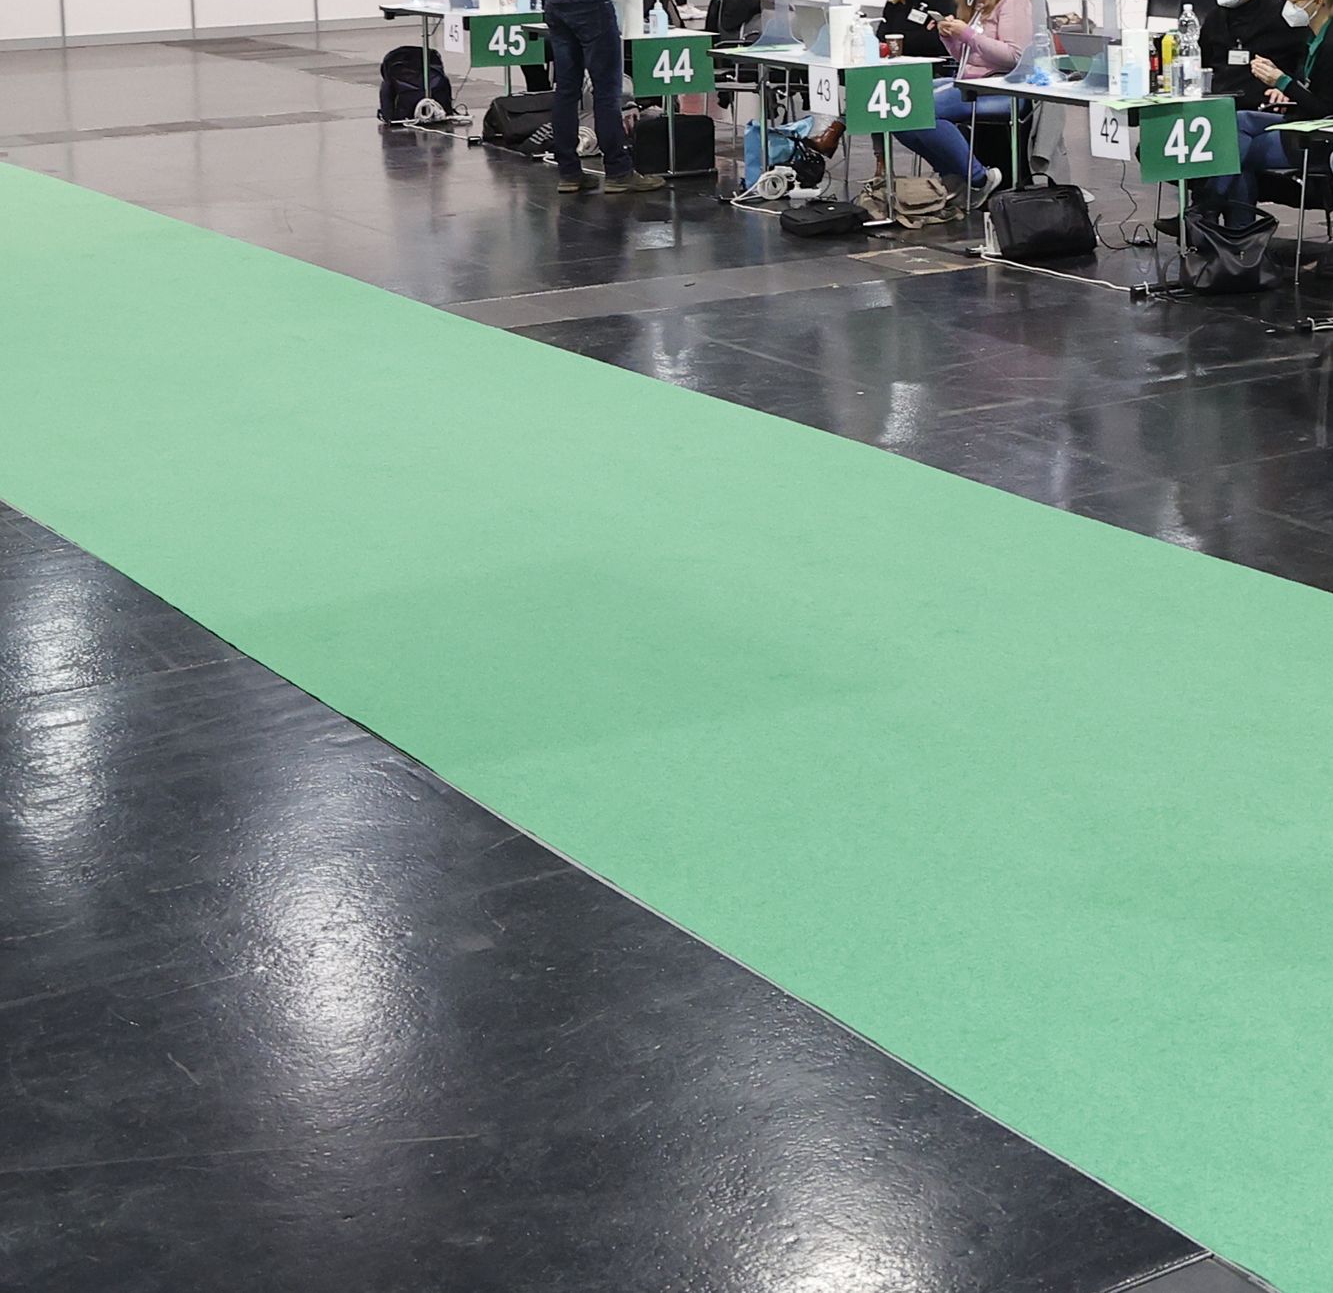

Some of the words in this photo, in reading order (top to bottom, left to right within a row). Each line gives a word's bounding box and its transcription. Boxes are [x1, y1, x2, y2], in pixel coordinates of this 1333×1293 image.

[448, 23, 460, 44] 45
[488, 25, 526, 57] 45
[652, 48, 694, 84] 44
[816, 78, 831, 102] 43
[867, 78, 912, 119] 43
[1100, 117, 1120, 144] 42
[1164, 116, 1214, 164] 42
